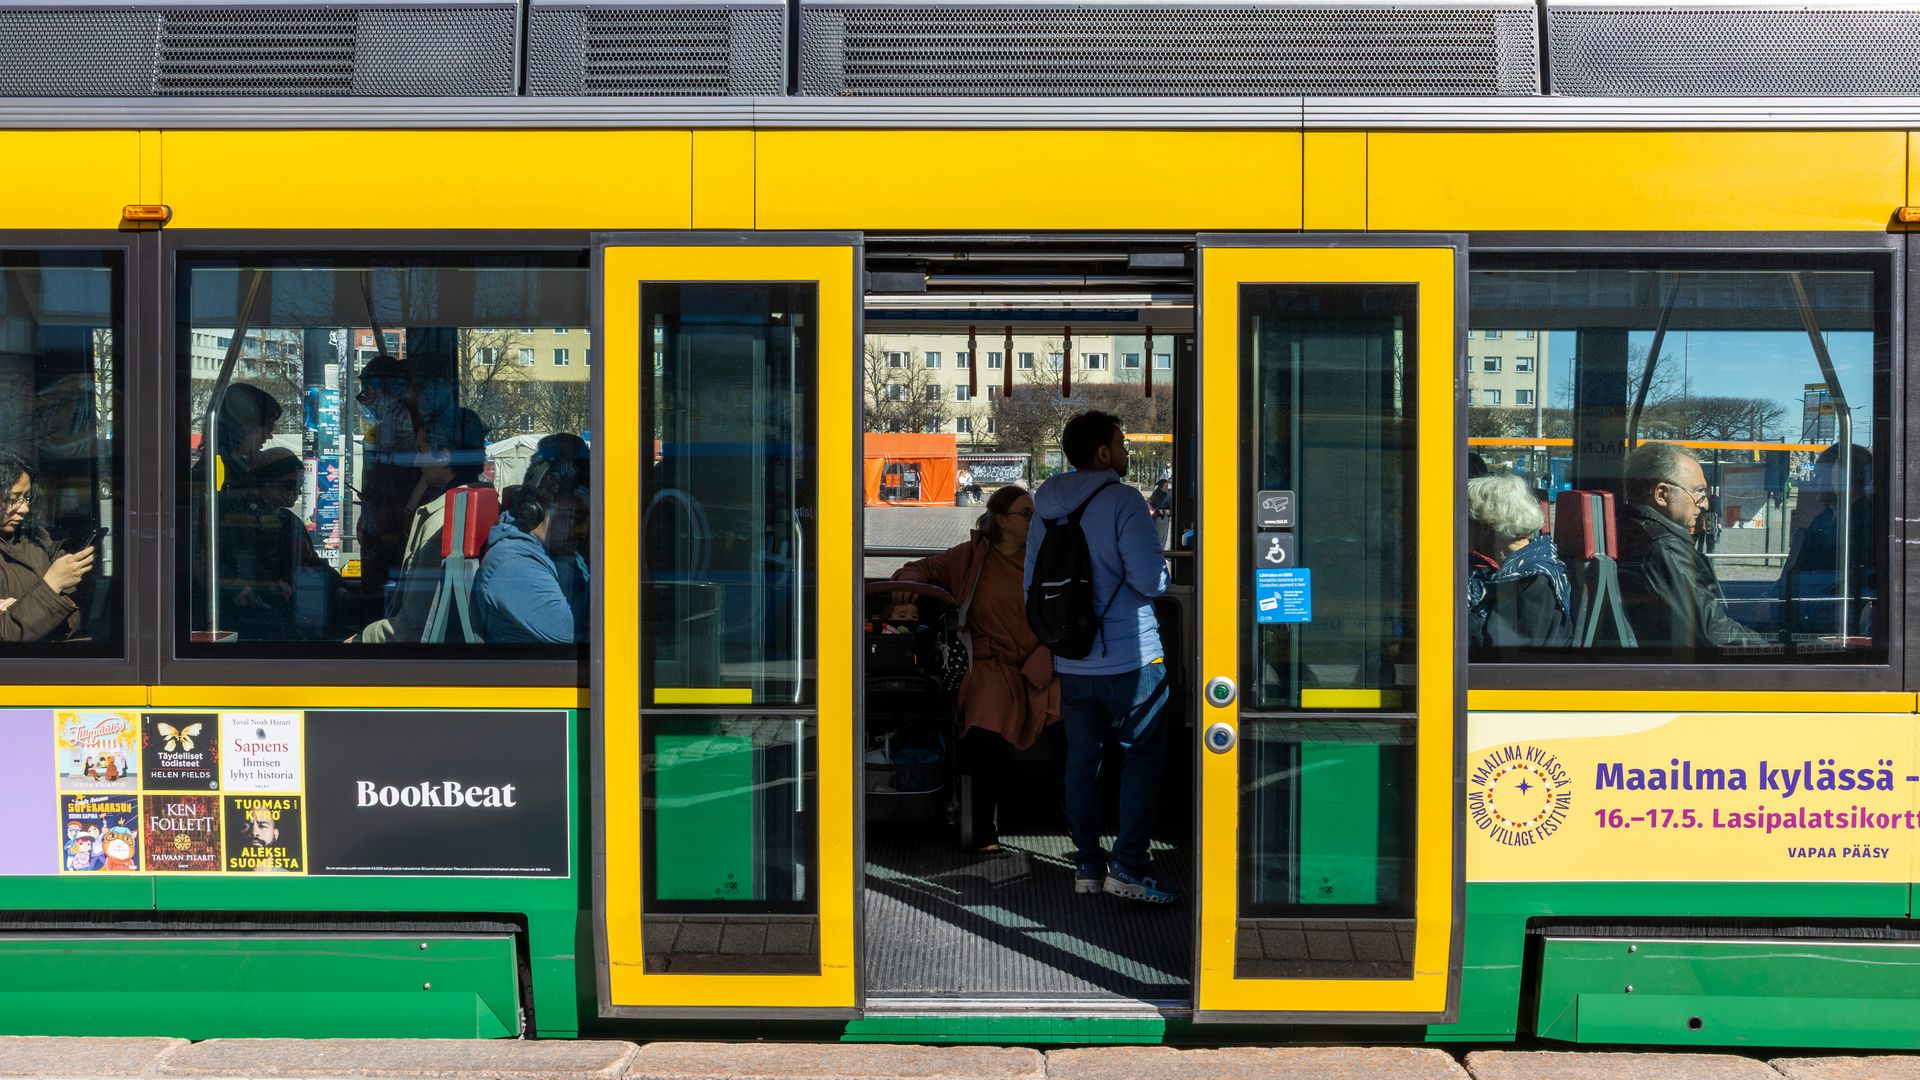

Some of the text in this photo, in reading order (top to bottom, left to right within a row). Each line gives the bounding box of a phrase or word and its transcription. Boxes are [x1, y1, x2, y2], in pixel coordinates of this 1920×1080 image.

[146, 716, 150, 724] 1
[234, 738, 288, 756] Sapiens
[158, 752, 203, 760] Täydelliset
[243, 758, 280, 766] Ihmisen
[1472, 745, 1572, 788] MAAILMA KYLÄSSÄ
[230, 770, 293, 781] lyhyt historia
[1595, 759, 1747, 791] Maailma
[1760, 759, 1894, 798] kylässä
[356, 781, 517, 808] BookBeat
[167, 804, 196, 816] KEN
[235, 800, 290, 810] TUOMAS
[246, 809, 280, 820] KYRÖ
[1468, 791, 1571, 846] WORLD VILLAGE FESTIVAL
[150, 817, 214, 831] FOLLETT
[242, 848, 286, 857] ALEKSI
[1788, 844, 1889, 859] VAPAA PÄÄSY
[230, 858, 298, 868] SUOMESTA
